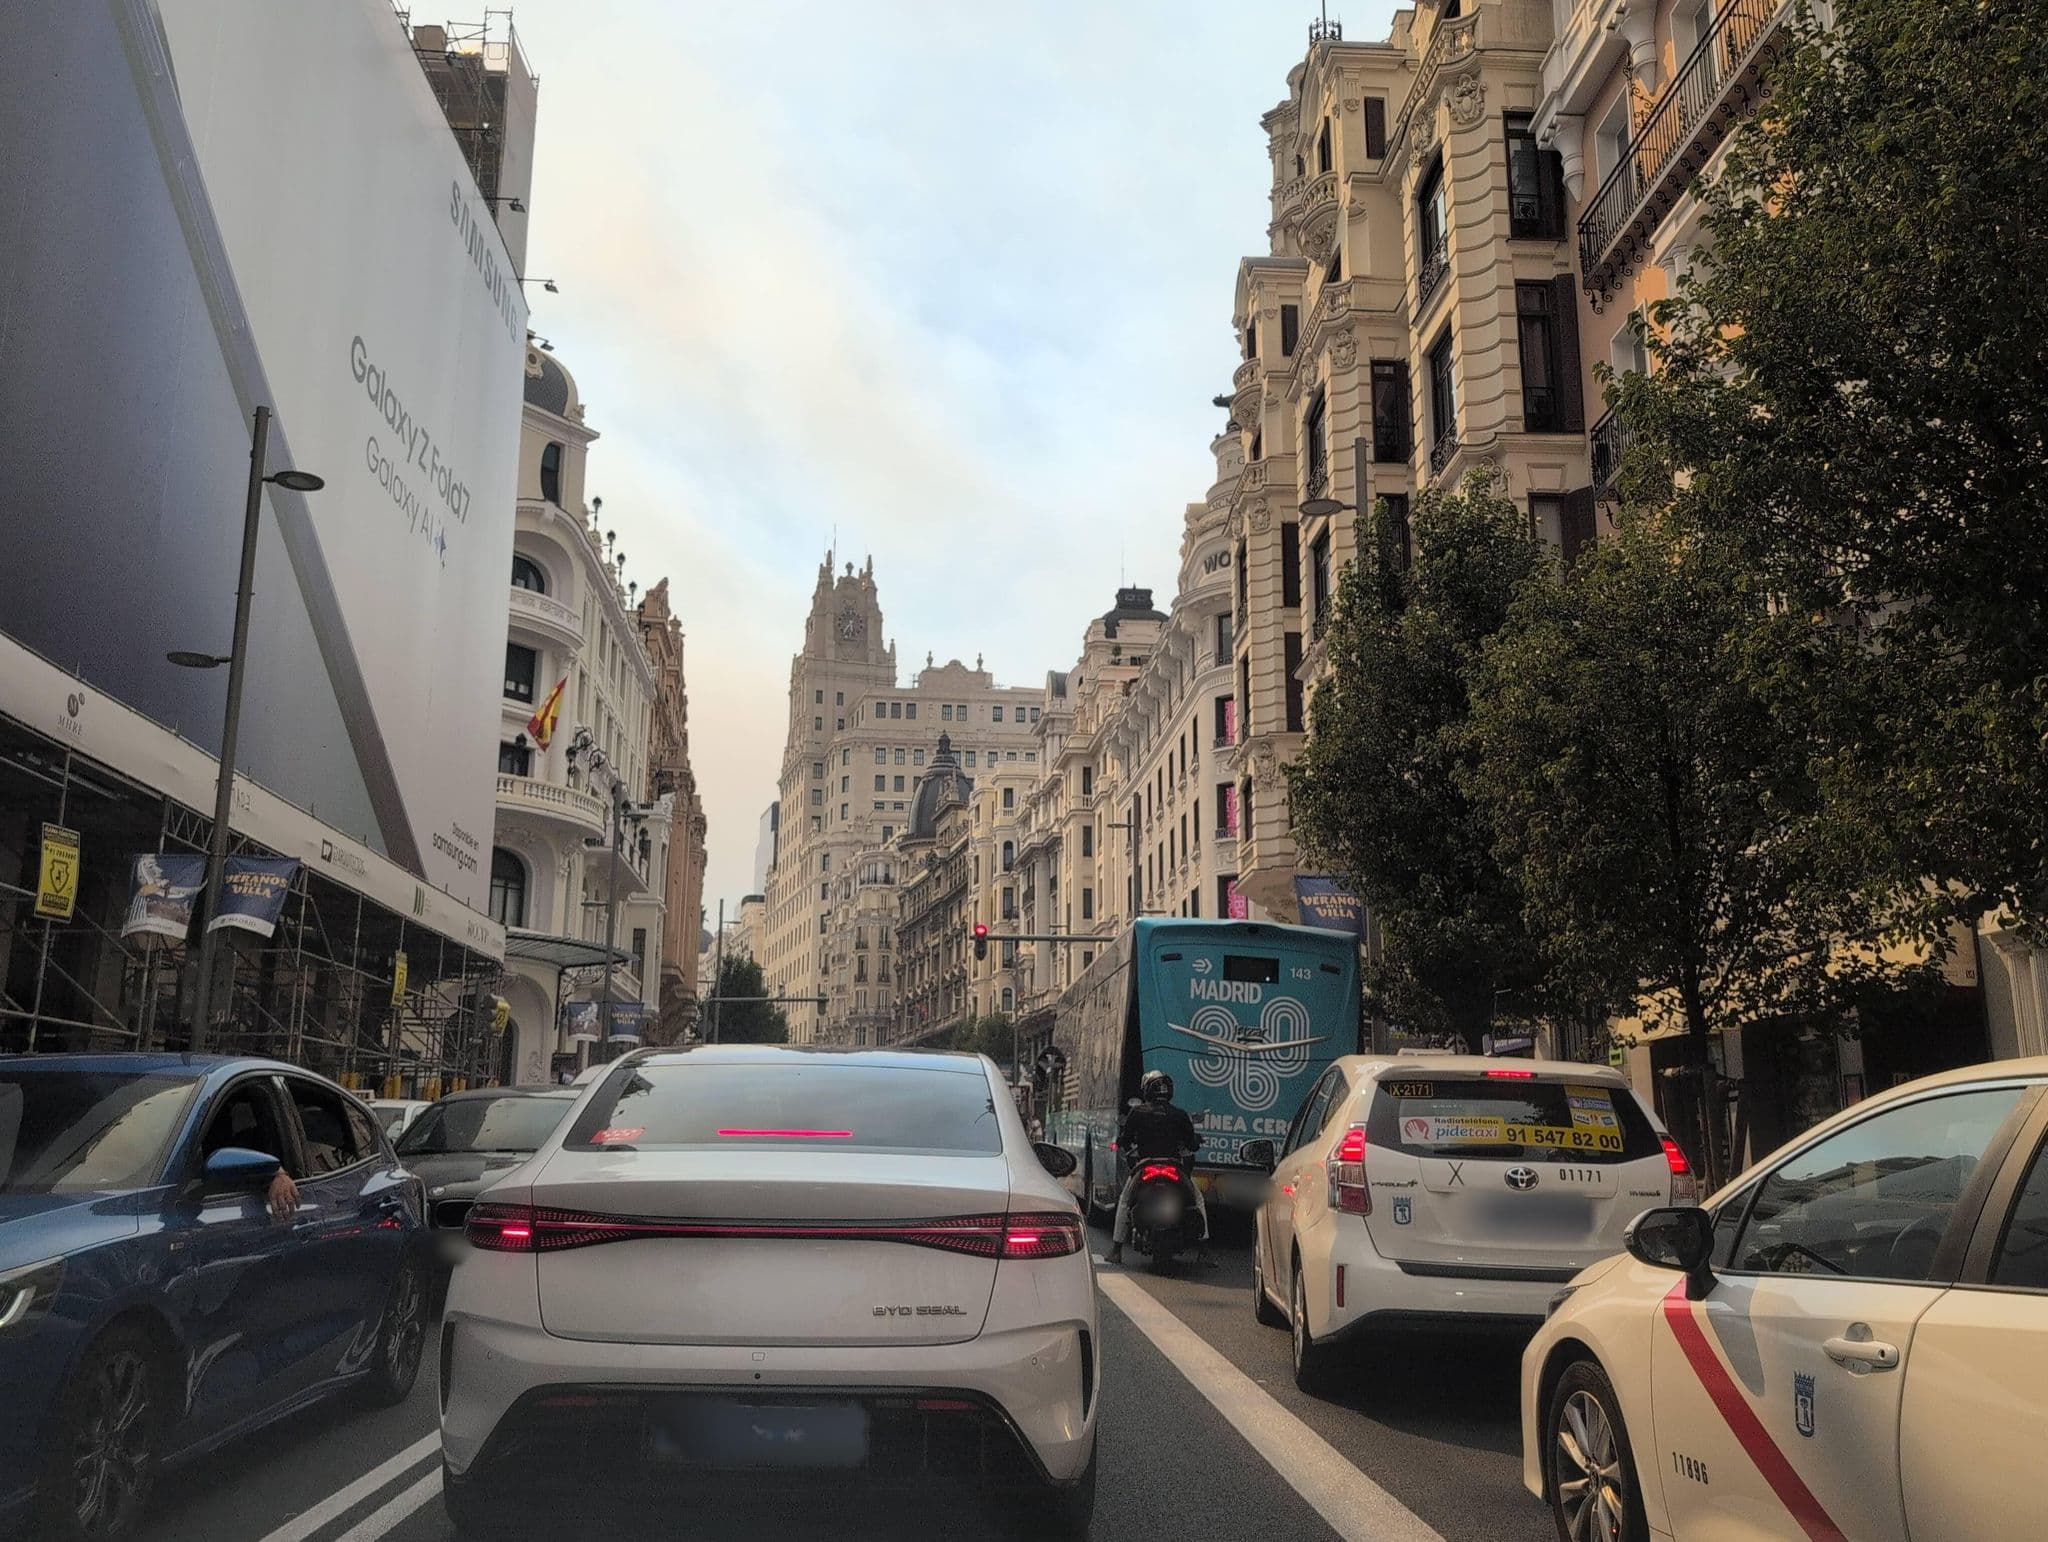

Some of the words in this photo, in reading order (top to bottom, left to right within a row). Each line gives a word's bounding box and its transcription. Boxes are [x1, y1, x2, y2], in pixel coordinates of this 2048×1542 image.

[450, 180, 517, 343] SAMSUNG
[351, 335, 418, 464] Galaxy
[418, 427, 430, 473] Z
[431, 445, 470, 524] Fold7
[366, 436, 419, 534] Galaxy
[420, 507, 434, 545] AI
[225, 874, 288, 888] VERANOS
[232, 884, 272, 899] VILLA
[1301, 895, 1361, 907] VERANOS
[1315, 907, 1356, 919] VILLA
[1290, 967, 1312, 980] 143
[1190, 978, 1262, 1004] MADRID
[1392, 1083, 1430, 1097] X-2171
[1436, 1124, 1498, 1139] pidetaxi
[1506, 1128, 1527, 1143] 91
[1534, 1129, 1565, 1145] 547
[1572, 1131, 1594, 1147] 82
[1599, 1134, 1620, 1149] 00
[1199, 1137, 1229, 1150] ERO
[1208, 1151, 1241, 1165] CERO
[1448, 1160, 1465, 1186] X
[1559, 1168, 1602, 1182] 01171
[872, 1305, 912, 1316] BYD
[916, 1305, 968, 1316] SEAL
[1672, 1451, 1709, 1486] 11896
